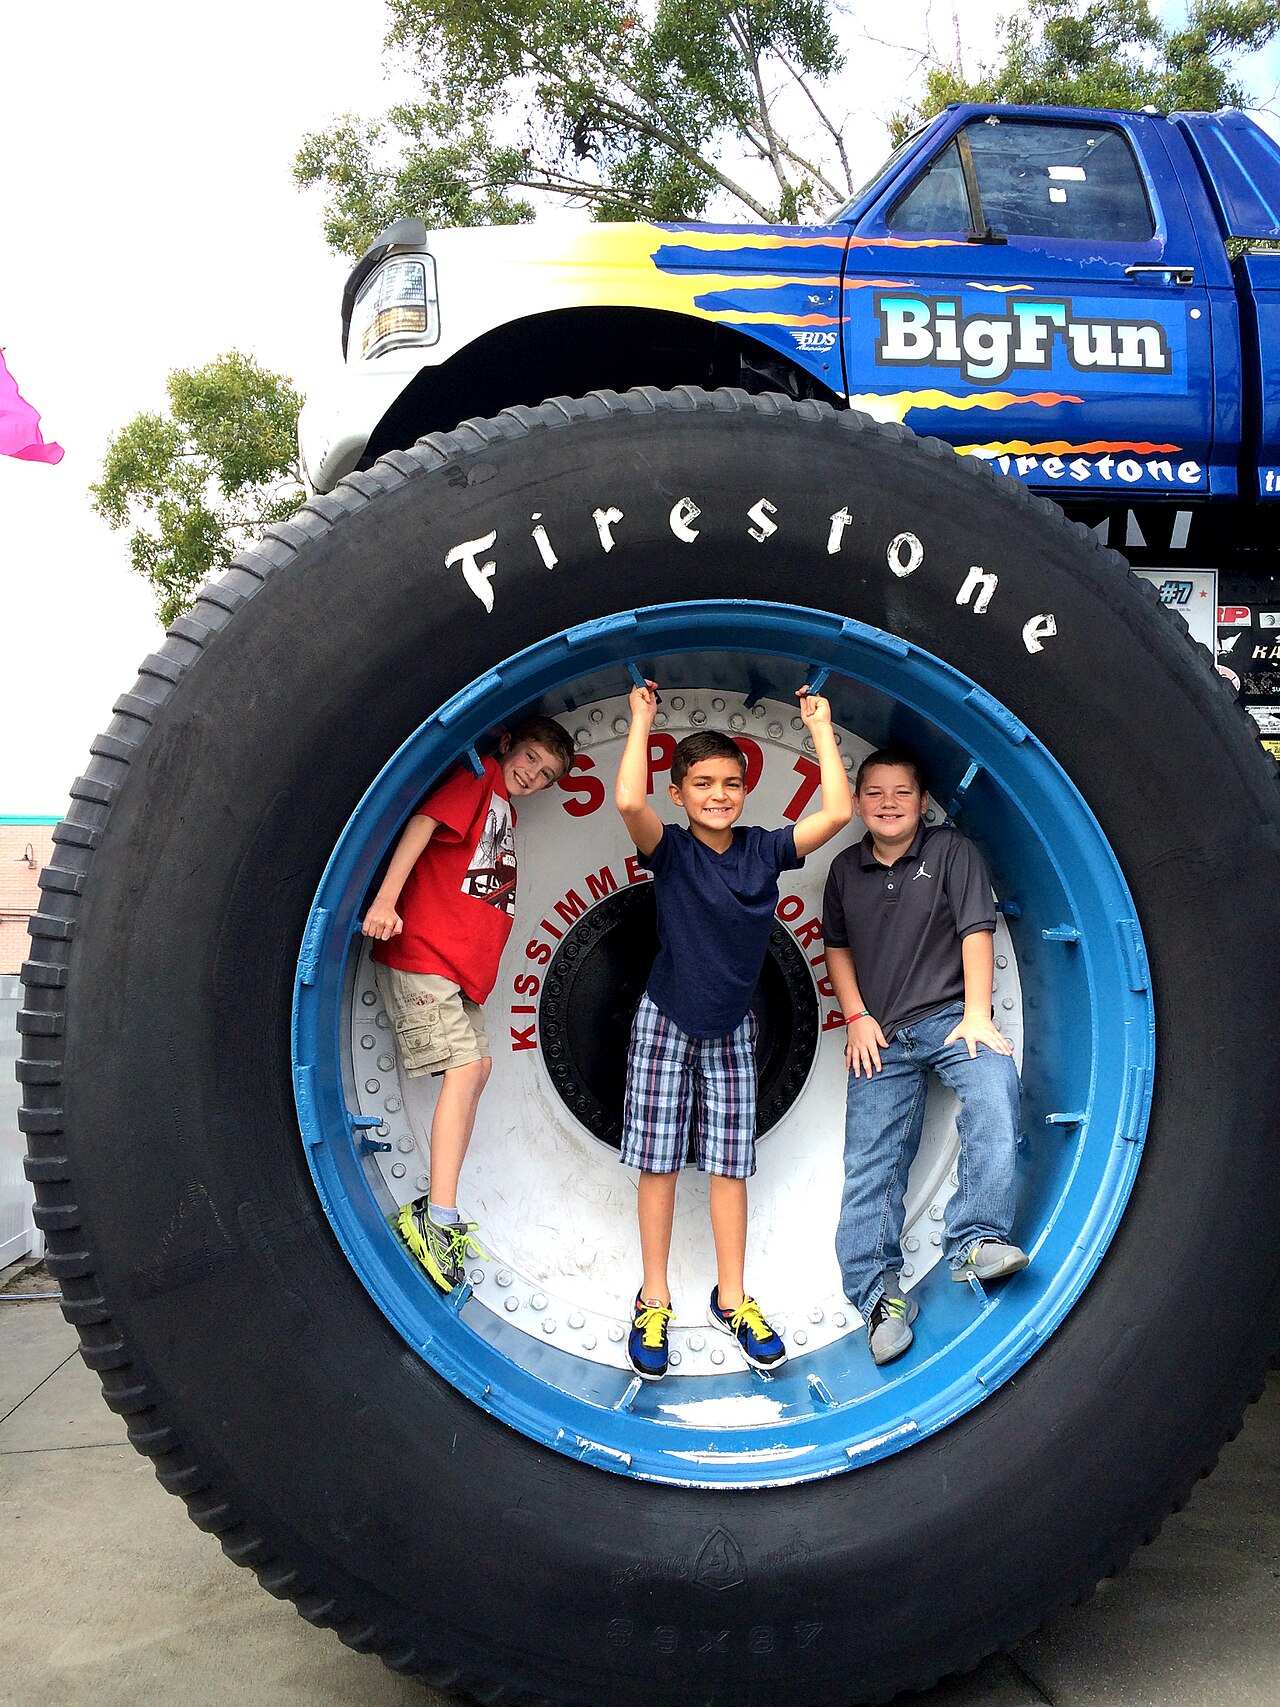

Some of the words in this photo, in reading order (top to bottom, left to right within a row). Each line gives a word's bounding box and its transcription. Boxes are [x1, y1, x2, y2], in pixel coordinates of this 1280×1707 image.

[792, 331, 838, 345] BDS
[876, 295, 1169, 382] BigFun
[972, 449, 1201, 483] irestone
[444, 496, 1058, 655] Firestone
[1160, 580, 1193, 604] #7
